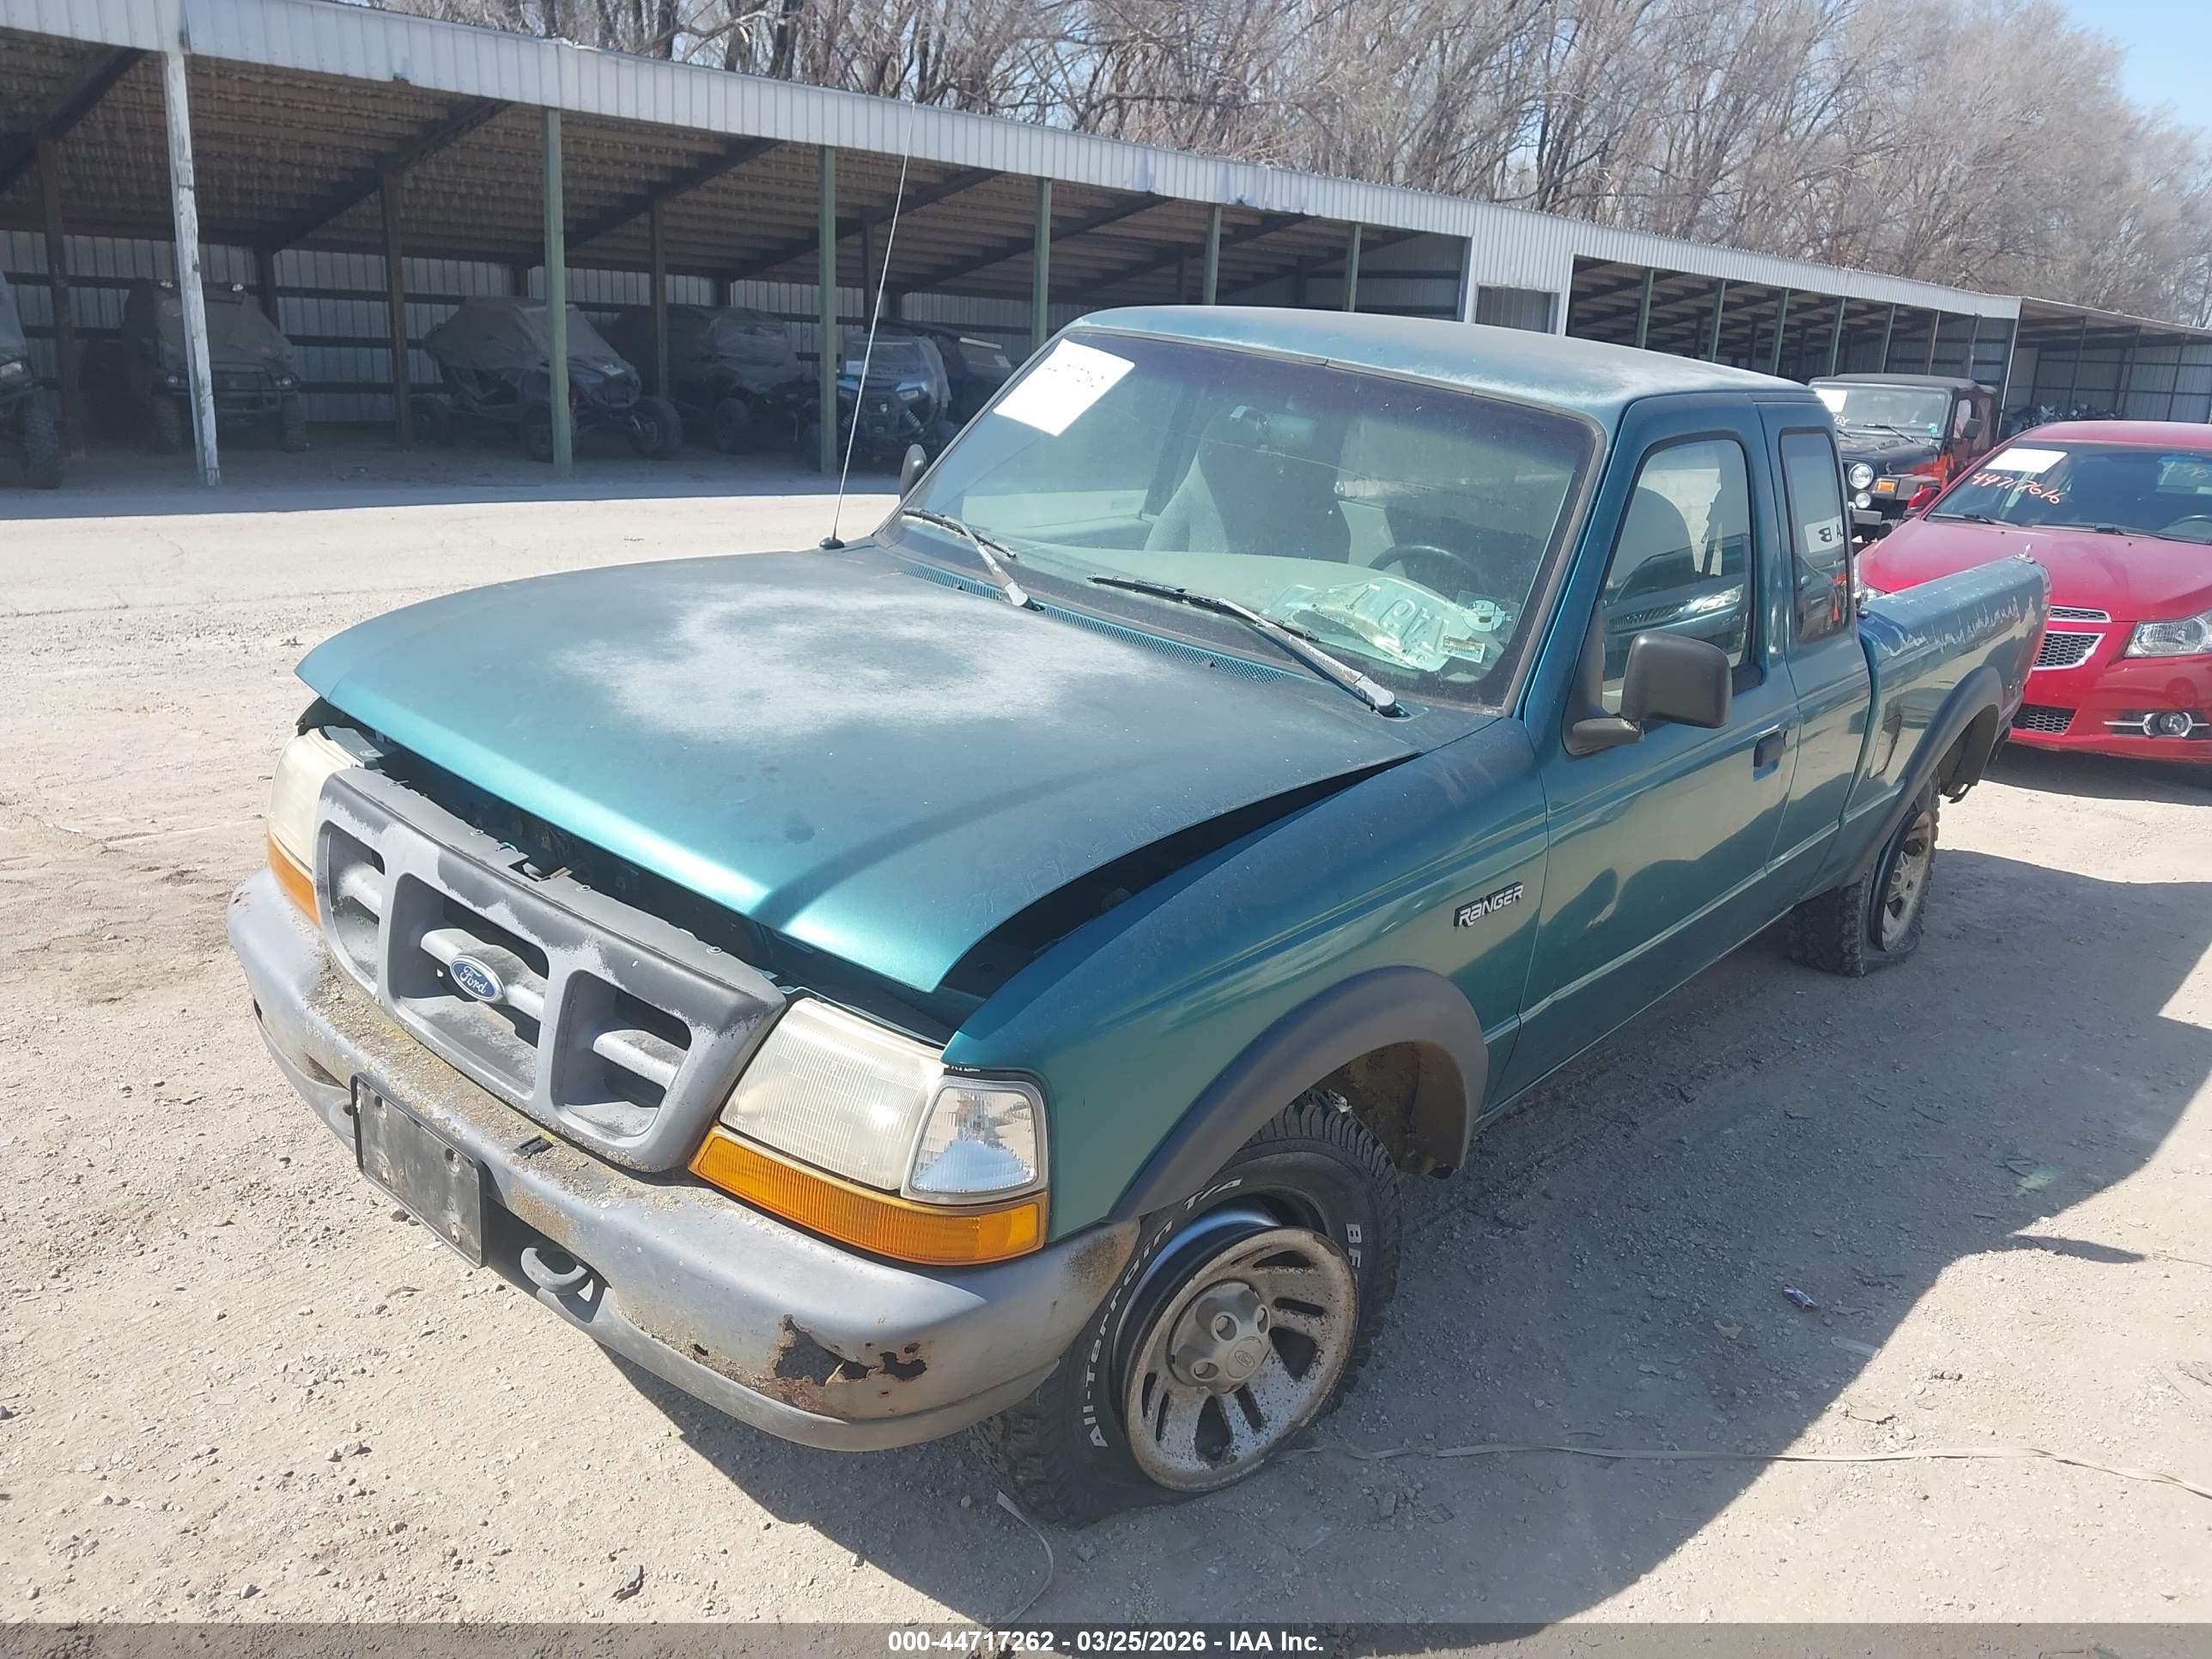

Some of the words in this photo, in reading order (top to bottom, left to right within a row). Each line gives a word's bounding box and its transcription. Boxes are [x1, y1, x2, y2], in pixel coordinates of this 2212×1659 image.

[1972, 472, 2067, 504] 44717616
[1456, 882, 1524, 927] RANGER
[459, 965, 489, 994] Ford
[1082, 1219, 1174, 1448] All-Terrain
[1183, 1177, 1243, 1212] T/A
